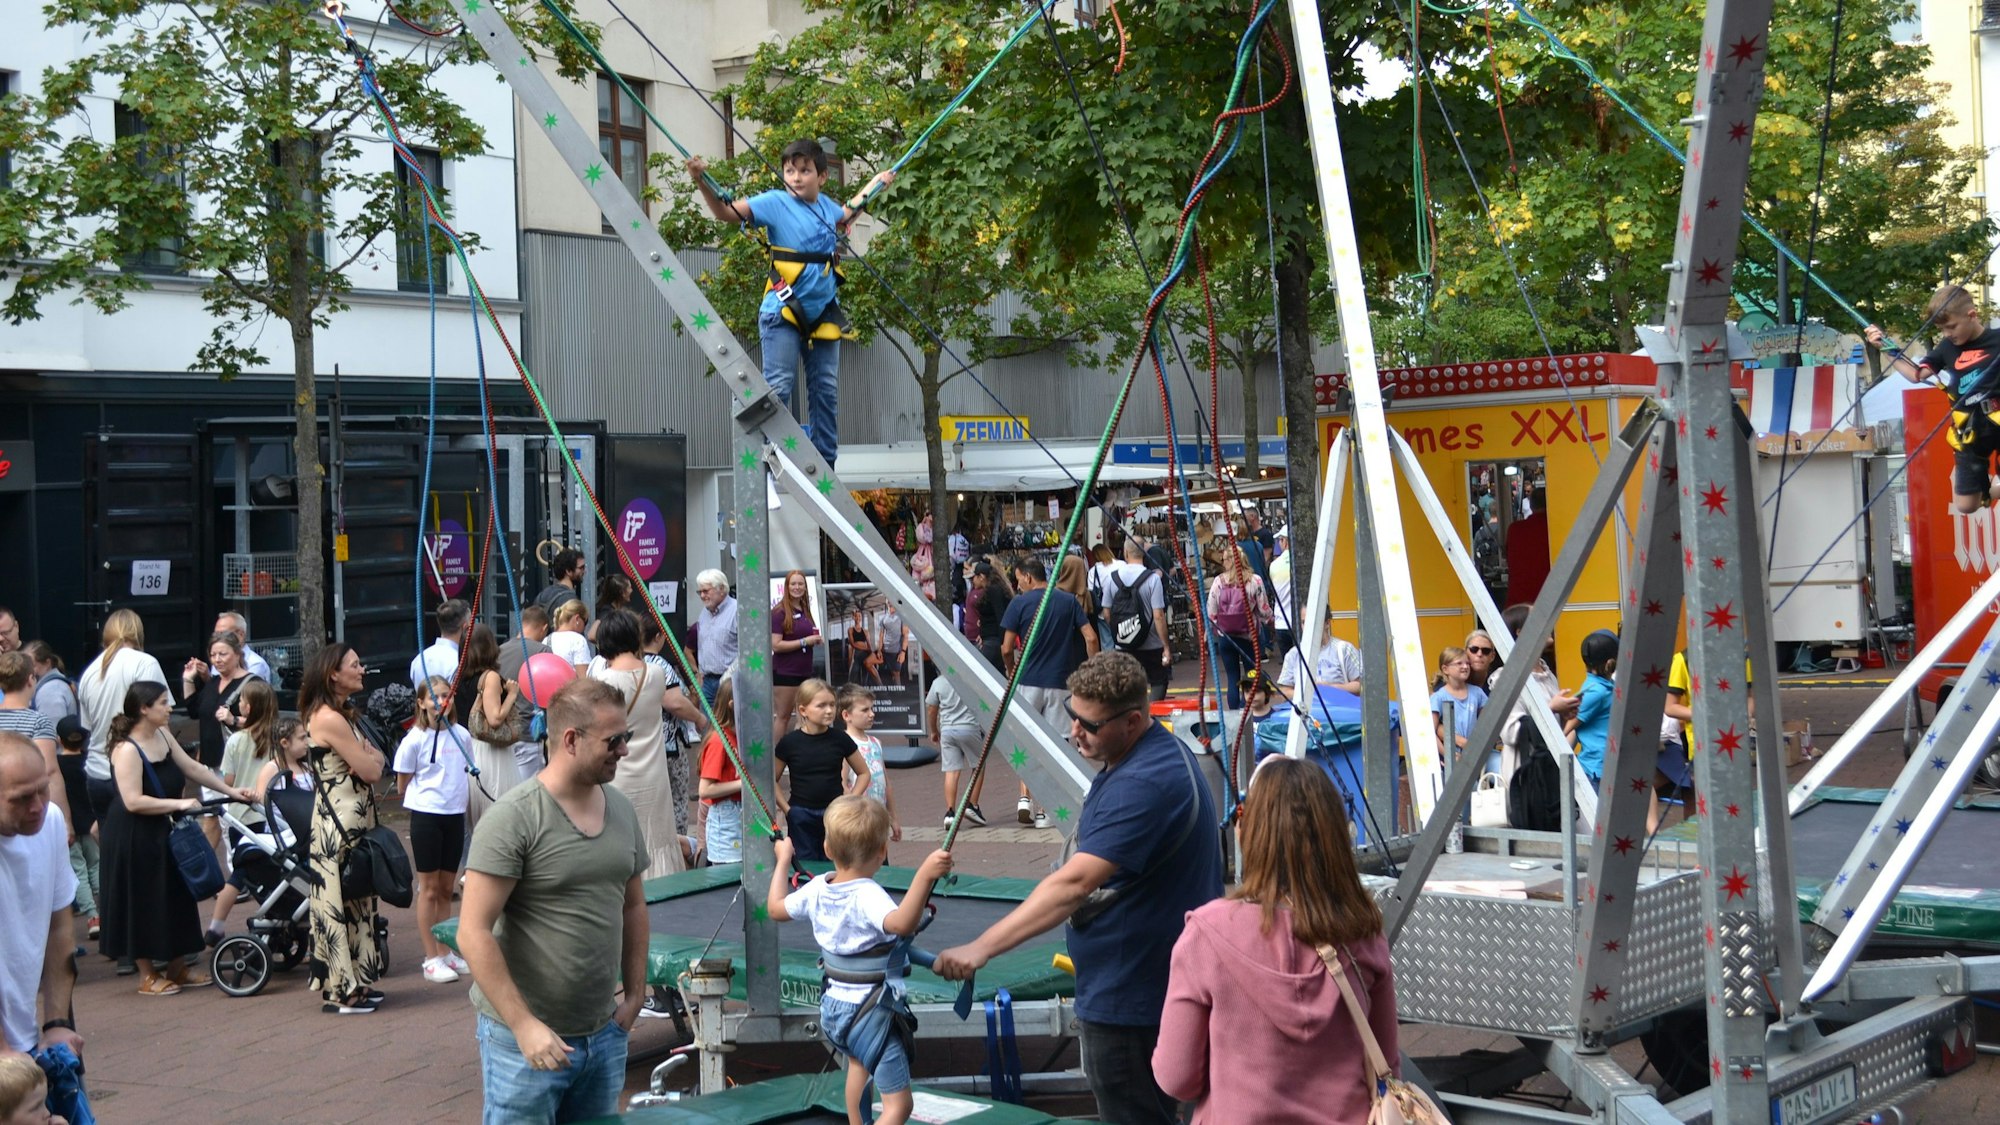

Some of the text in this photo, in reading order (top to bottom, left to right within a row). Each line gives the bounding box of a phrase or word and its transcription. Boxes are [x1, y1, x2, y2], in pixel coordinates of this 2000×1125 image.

[955, 421, 1024, 441] ZEEMAN
[1511, 405, 1606, 447] XXL
[639, 538, 656, 547] FAMILY
[639, 547, 659, 556] FITNESS
[446, 557, 461, 566] FAMILY
[639, 558, 653, 567] CLUB
[139, 575, 162, 590] 136
[446, 577, 458, 585] CLUB
[655, 594, 670, 607] 134
[1118, 614, 1140, 638] NIKE
[1784, 1090, 1811, 1125] CAS
